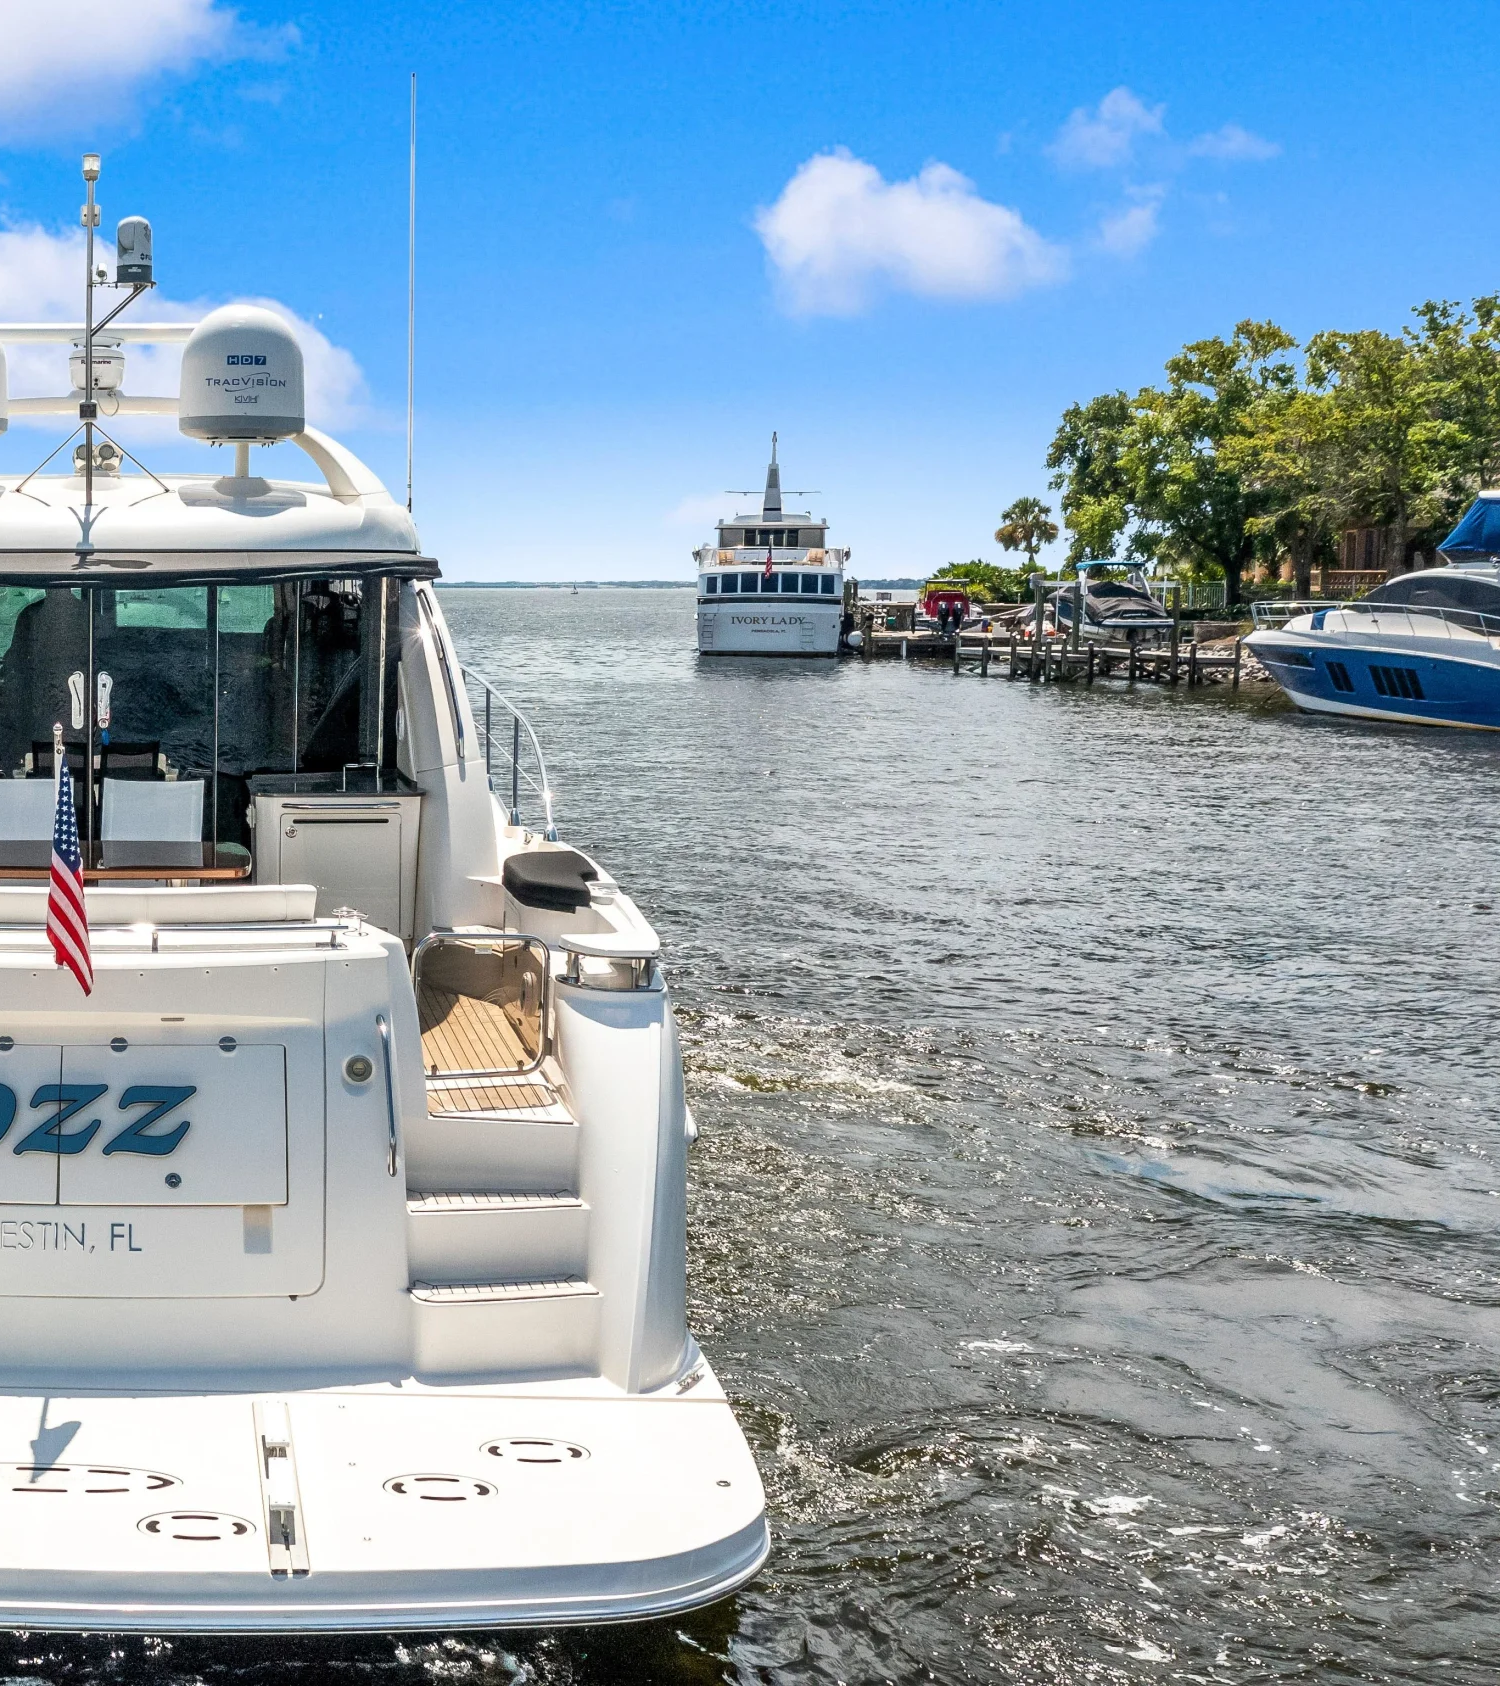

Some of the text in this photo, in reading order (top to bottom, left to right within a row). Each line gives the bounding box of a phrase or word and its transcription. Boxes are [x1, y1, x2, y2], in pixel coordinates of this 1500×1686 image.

[228, 356, 265, 364] HD7
[731, 616, 806, 624] IVORY LADY
[110, 1223, 142, 1251] FL
